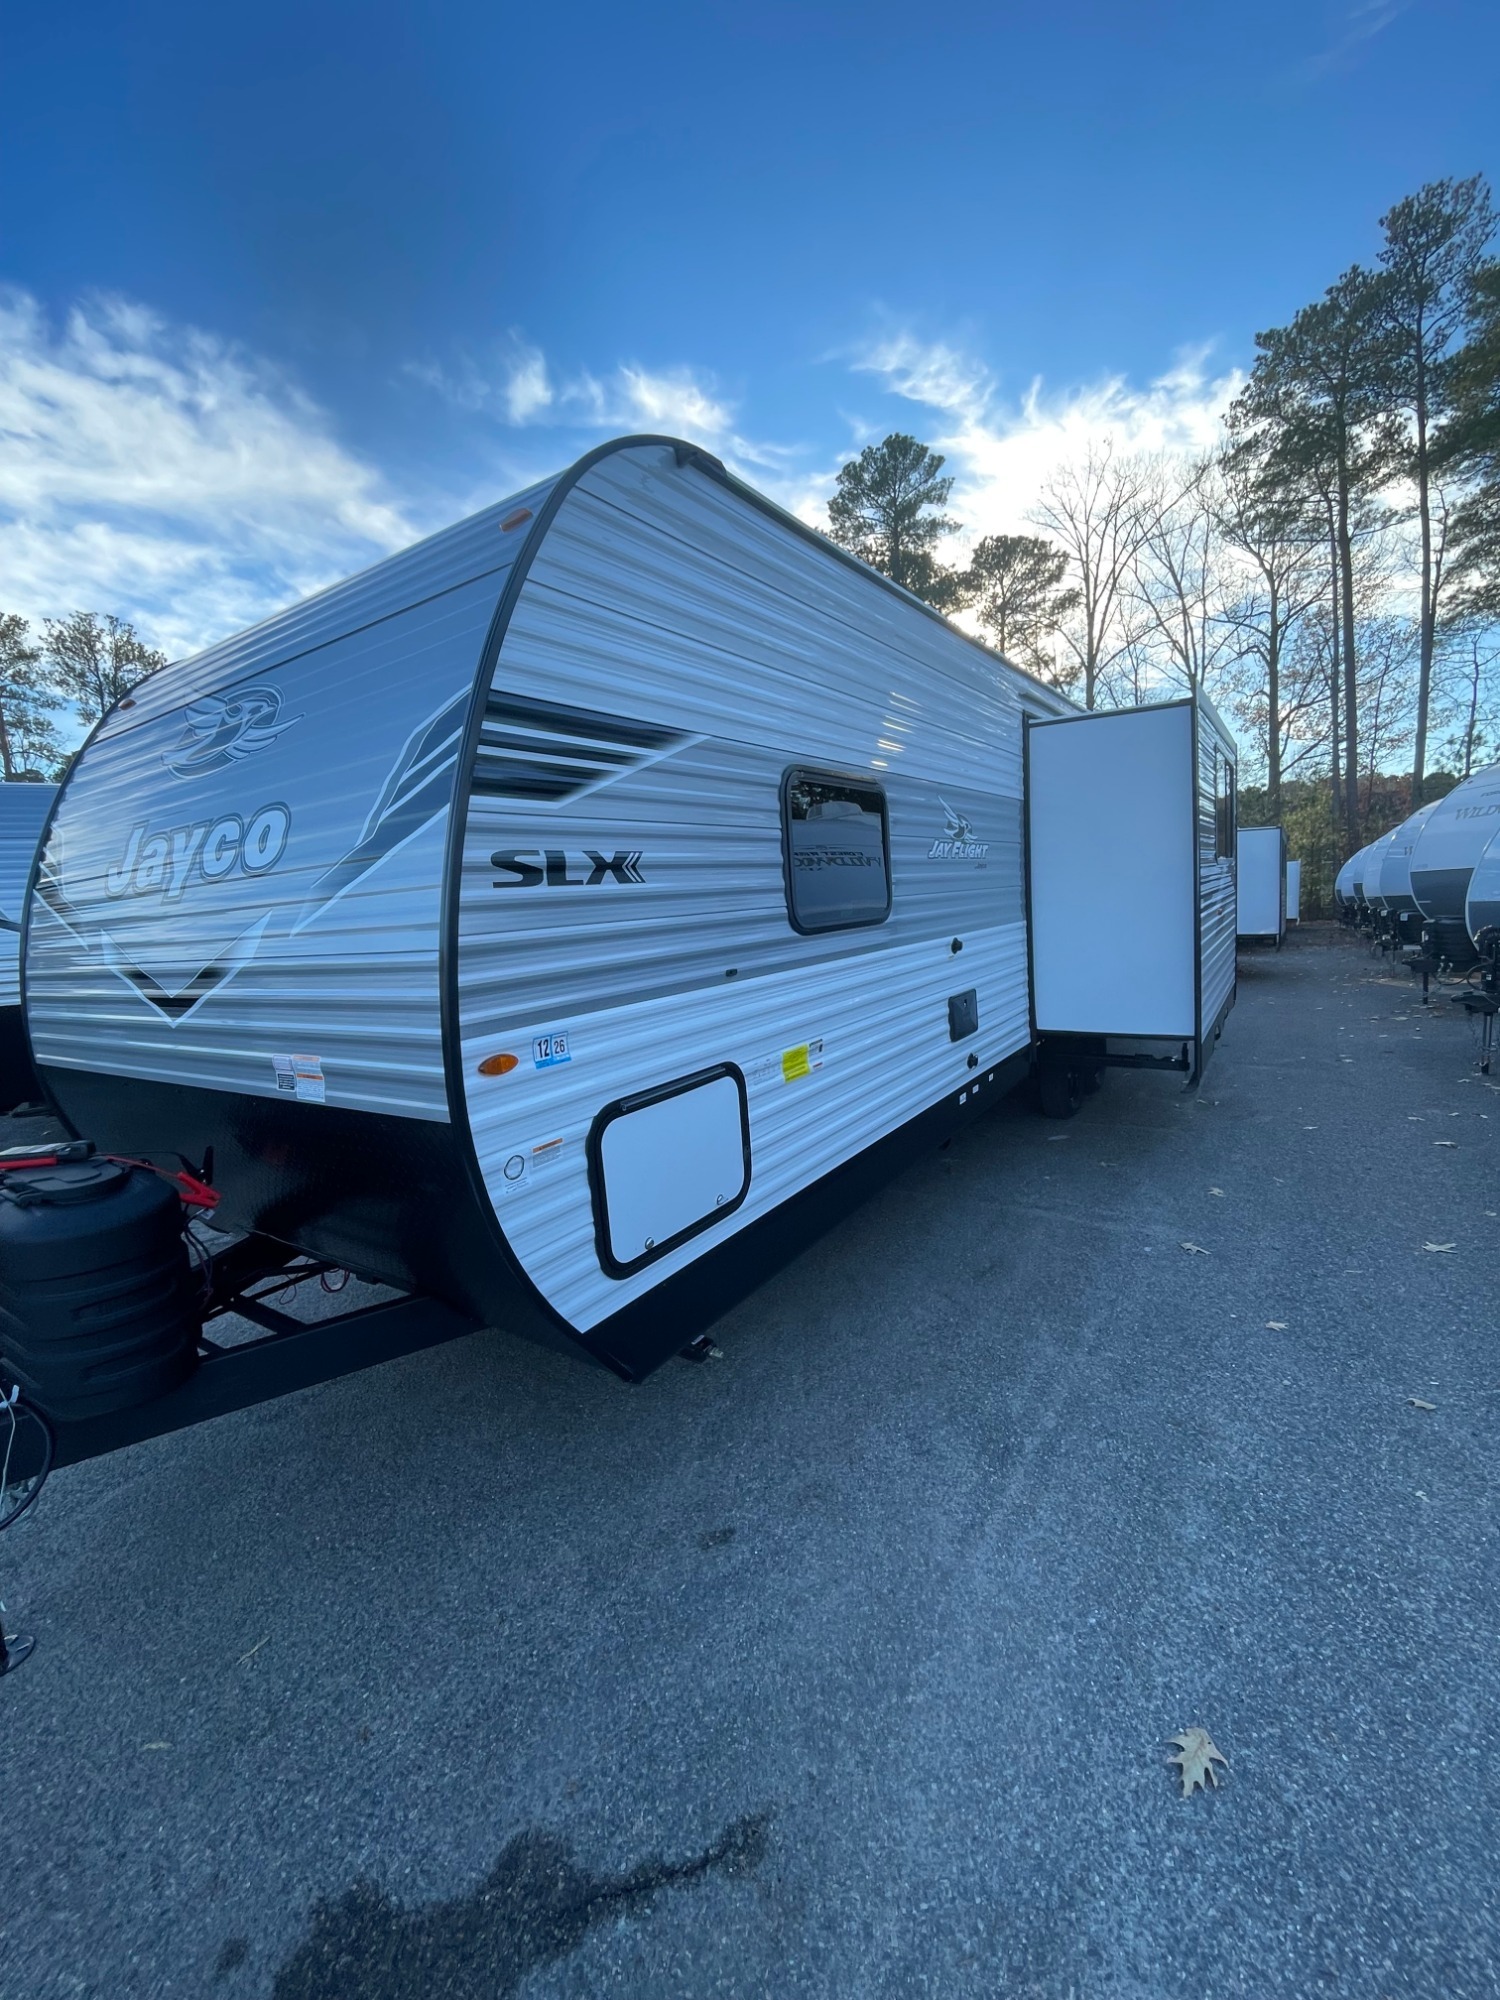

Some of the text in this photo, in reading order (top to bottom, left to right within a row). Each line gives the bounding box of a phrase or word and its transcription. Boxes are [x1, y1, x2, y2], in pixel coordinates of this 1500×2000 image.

[105, 802, 291, 905] Jayco
[928, 839, 989, 859] JAY FLIGHT
[490, 849, 646, 888] SLX
[537, 1038, 566, 1058] 12 26
